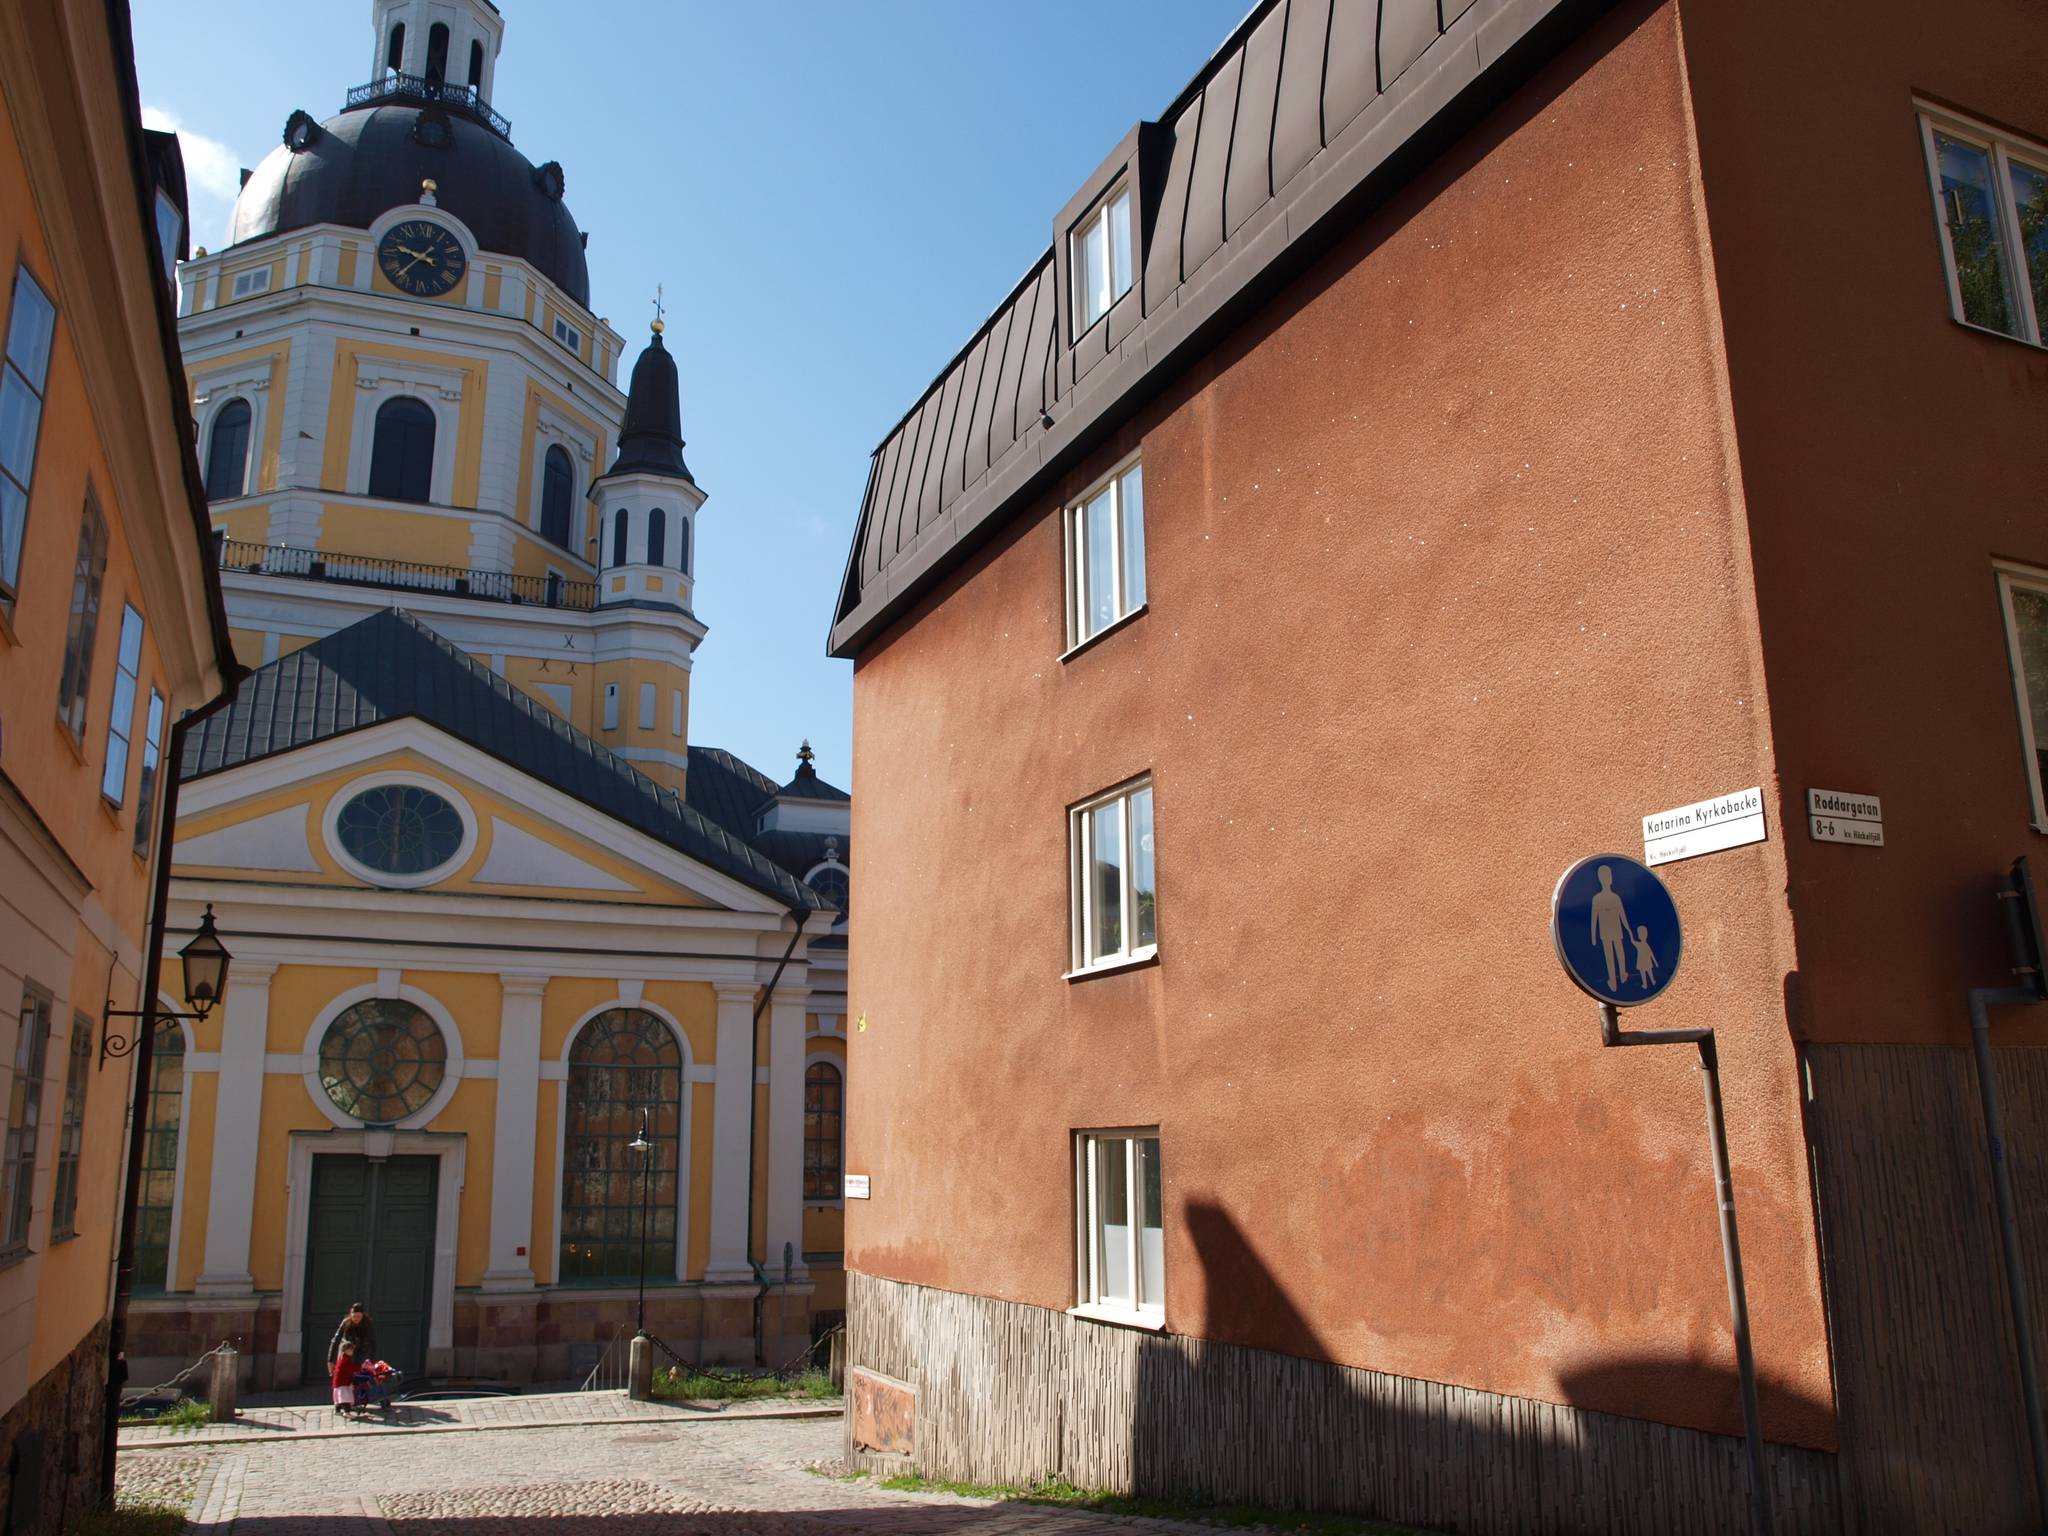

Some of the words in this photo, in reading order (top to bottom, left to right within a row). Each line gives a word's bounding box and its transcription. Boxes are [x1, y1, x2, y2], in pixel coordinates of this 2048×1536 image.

[1647, 815, 1691, 834] Katarina
[1695, 794, 1758, 825] Kyrkobacke
[1814, 794, 1879, 818] Roddargatan
[1816, 820, 1835, 836] 8-6
